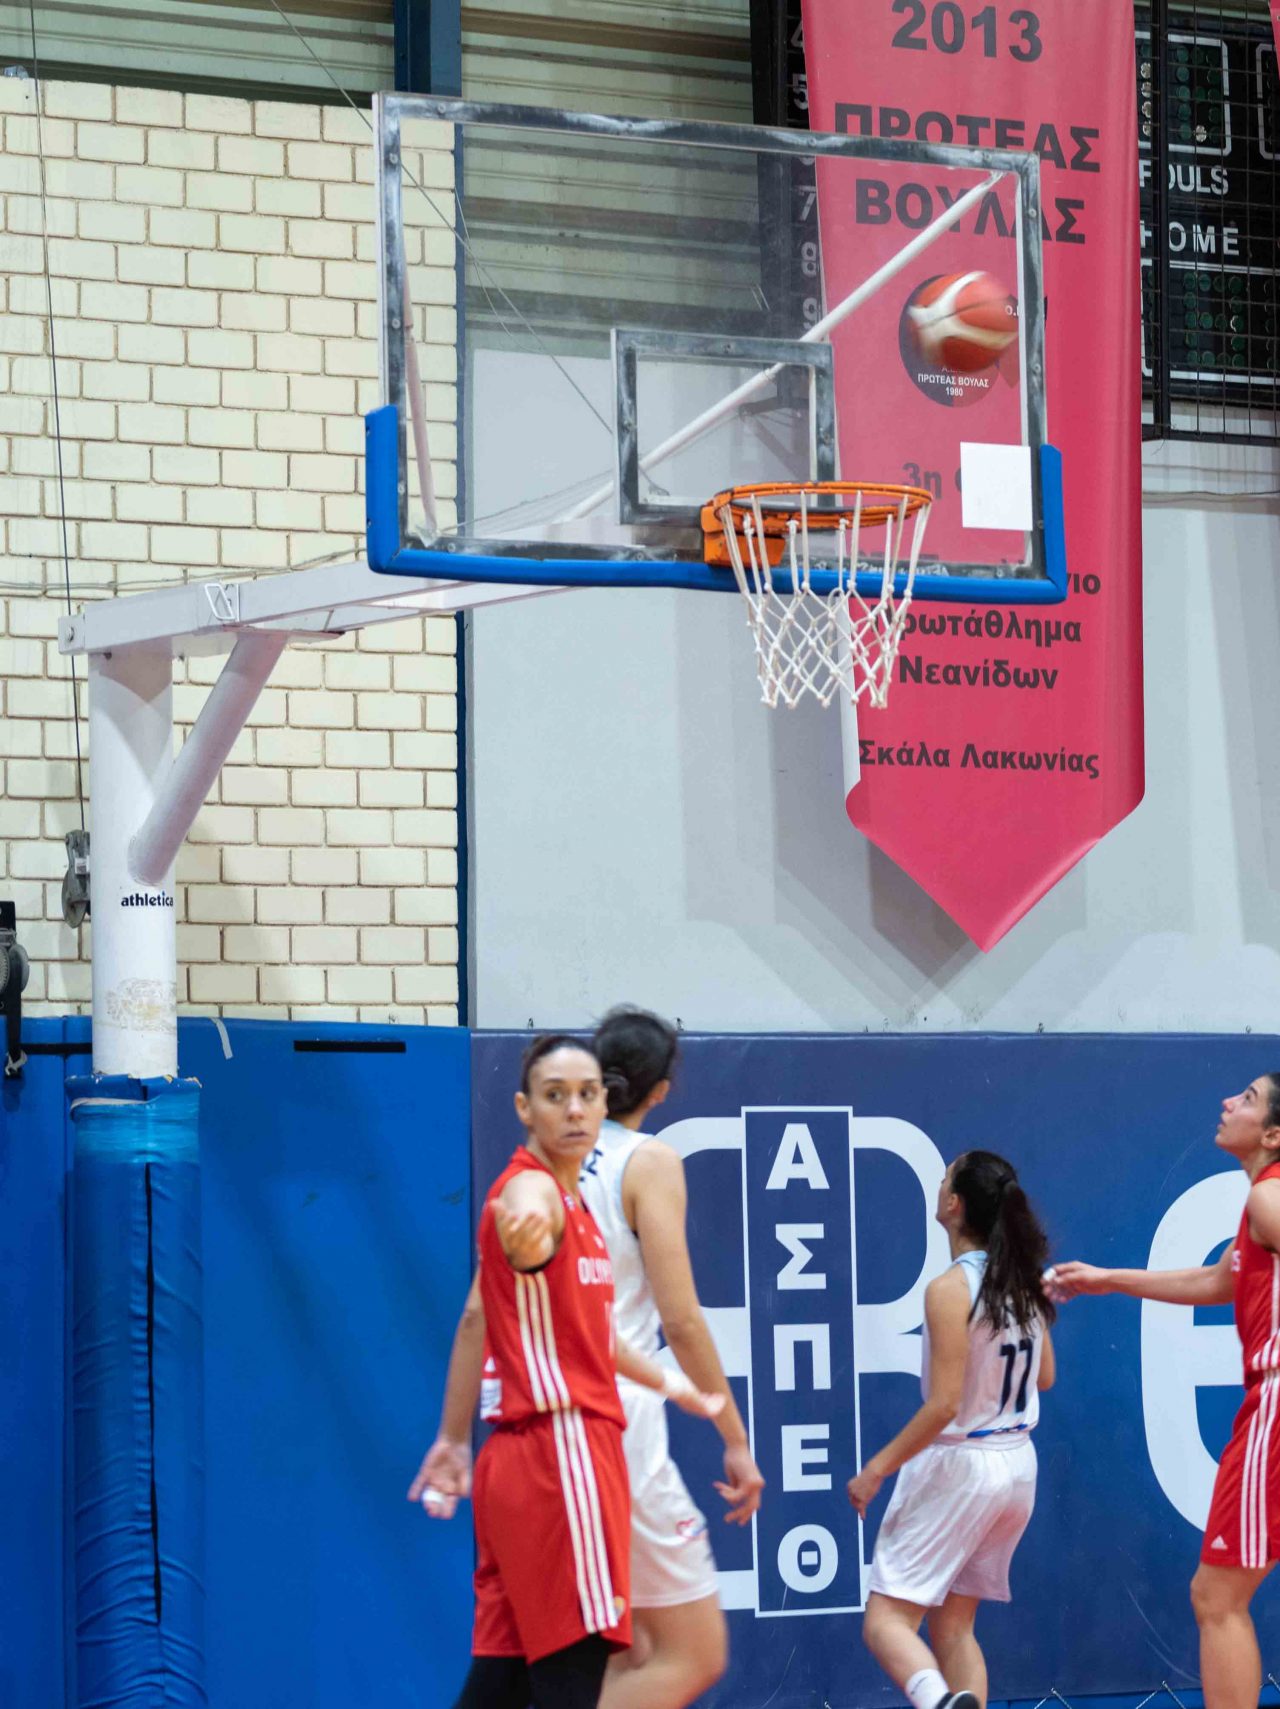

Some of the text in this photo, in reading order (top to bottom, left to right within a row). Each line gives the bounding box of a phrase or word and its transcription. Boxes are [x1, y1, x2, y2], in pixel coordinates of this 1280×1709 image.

[892, 1, 1043, 62] 2013
[918, 373, 989, 388] ΠΡΩΤΕΑΣ ΒΟΥΛΑΣ
[945, 387, 963, 397] 1980
[900, 655, 1058, 690] Νεανίδων
[859, 740, 1100, 779] Σκάλα Λακωνίας
[121, 890, 173, 907] athletica
